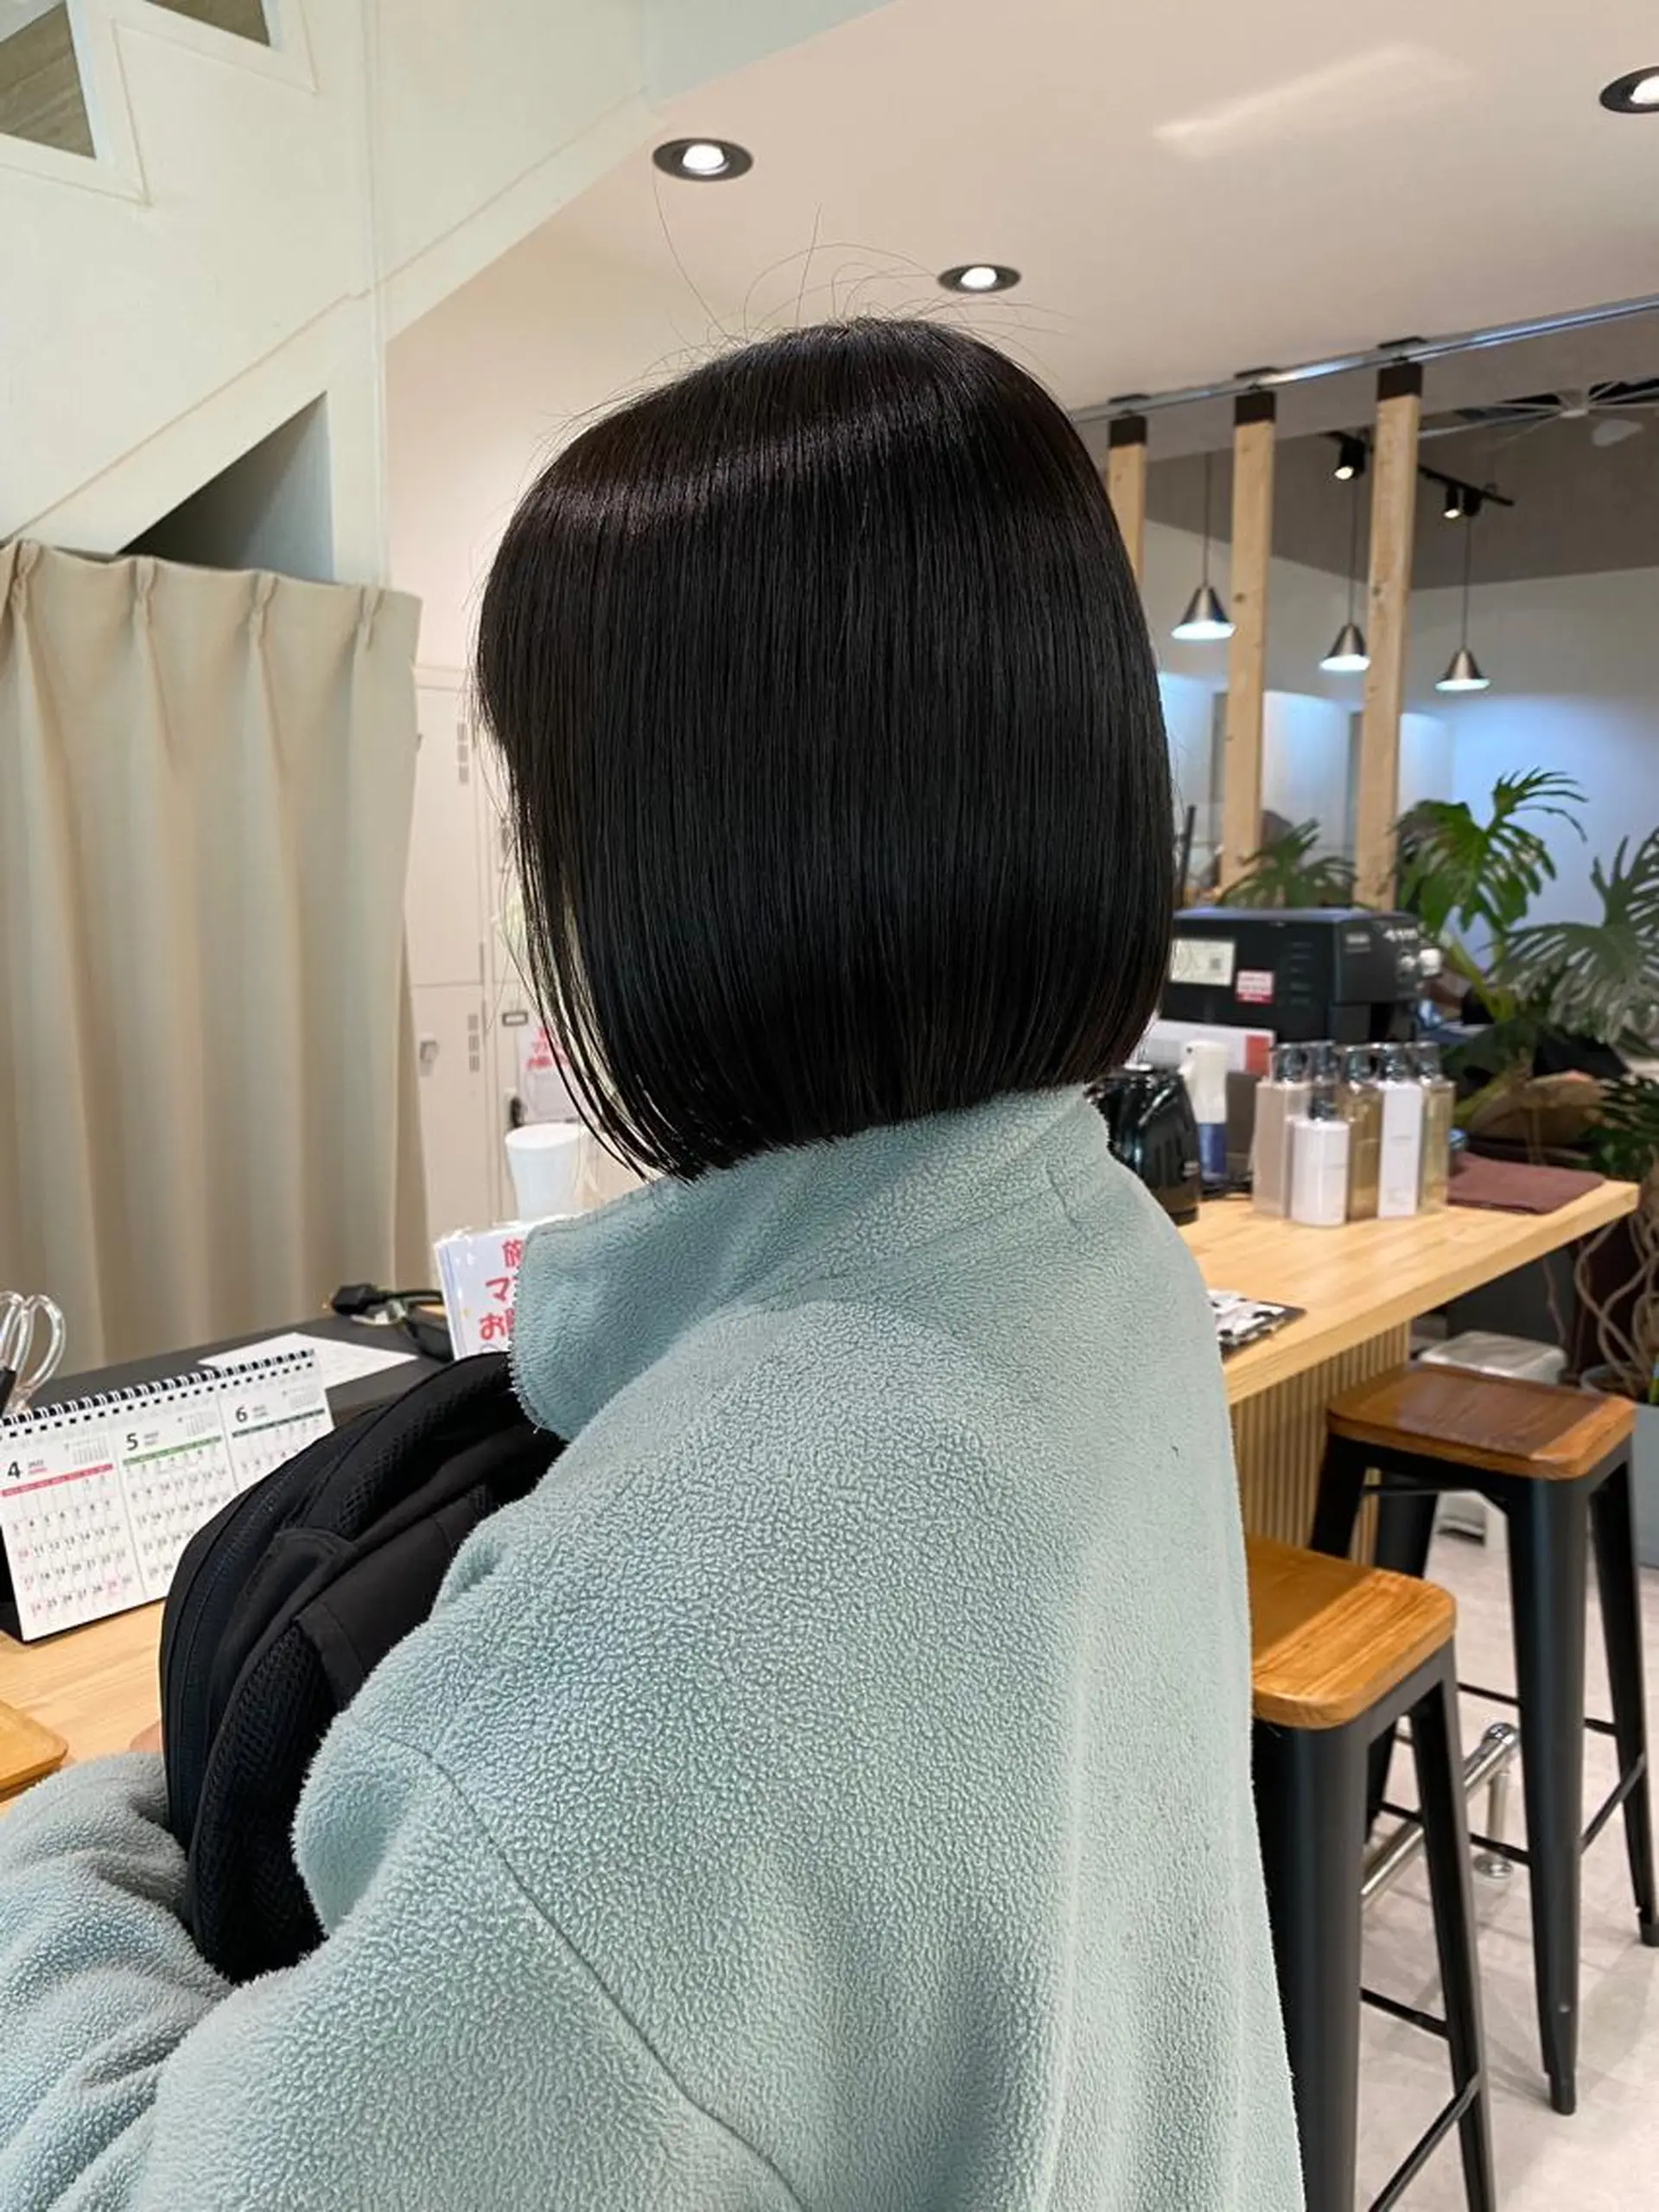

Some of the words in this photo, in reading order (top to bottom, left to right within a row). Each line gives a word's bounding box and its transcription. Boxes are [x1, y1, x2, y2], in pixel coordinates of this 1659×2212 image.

[235, 1405, 248, 1423] 6
[126, 1433, 139, 1451] 5
[8, 1461, 21, 1479] 4
